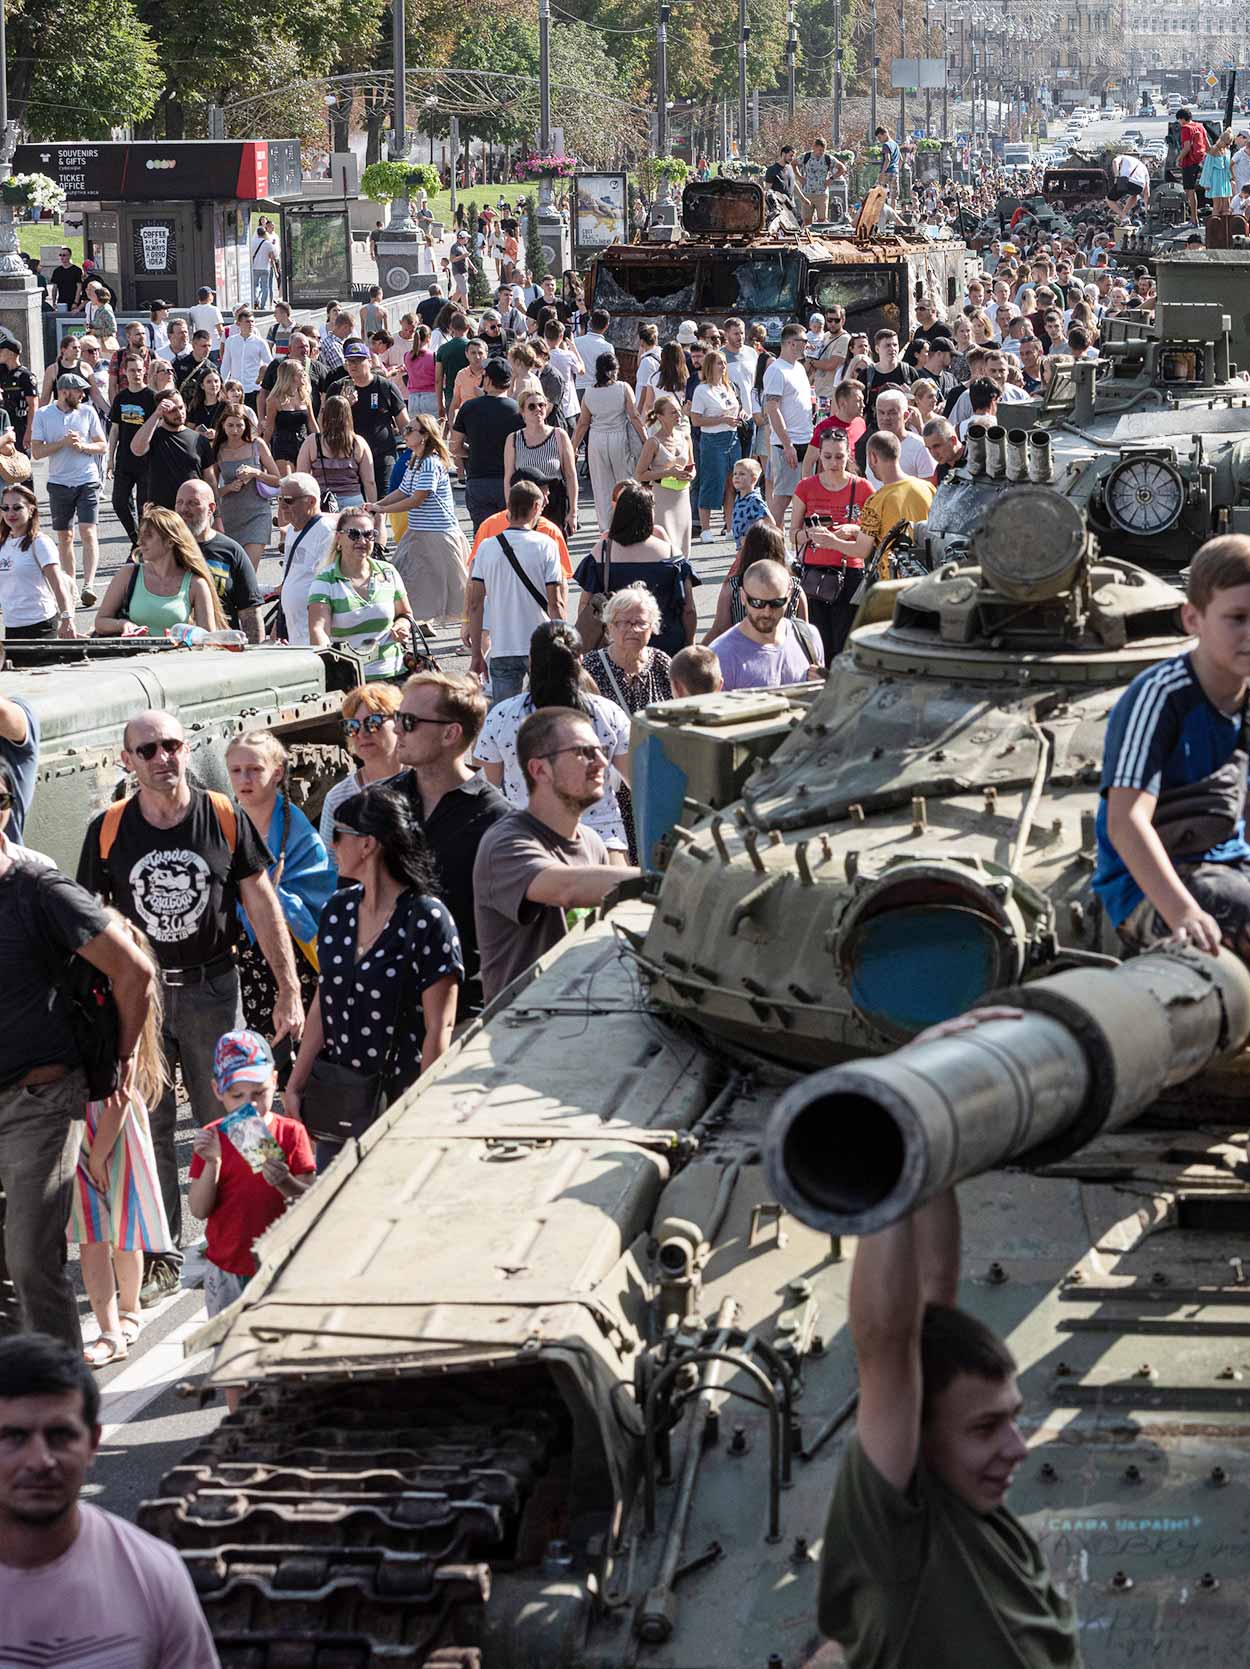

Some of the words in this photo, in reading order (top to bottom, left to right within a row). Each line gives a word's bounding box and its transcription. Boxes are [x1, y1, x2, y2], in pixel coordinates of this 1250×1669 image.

[57, 149, 99, 157] SOUVENIRS
[58, 174, 85, 182] TICKET
[58, 182, 86, 190] OFFICE
[160, 914, 182, 933] 30
[1050, 1519, 1109, 1531] СЛАВА
